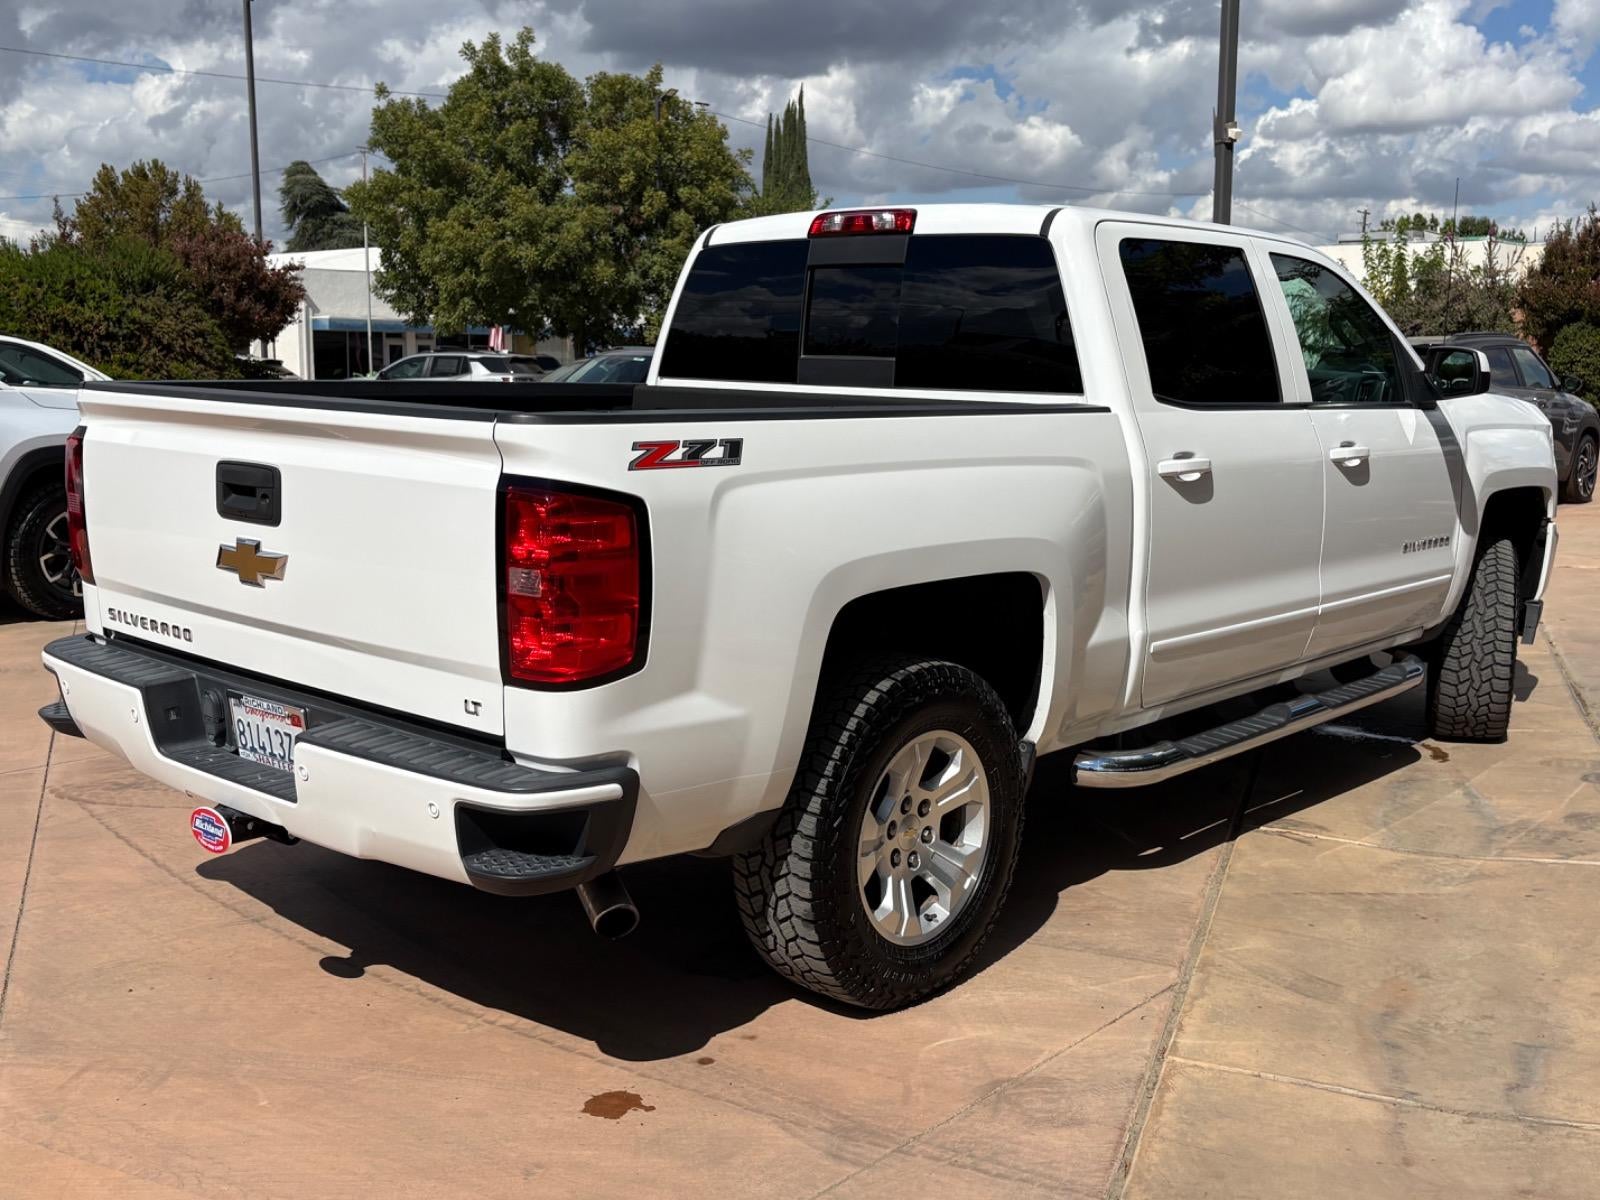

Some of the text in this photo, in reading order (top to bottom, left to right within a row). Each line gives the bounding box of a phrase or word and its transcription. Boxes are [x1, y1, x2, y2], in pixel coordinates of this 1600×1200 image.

[628, 438, 743, 470] Z71
[1403, 536, 1449, 554] SILVERADO
[108, 607, 193, 642] SILVERADO
[464, 699, 482, 716] LT
